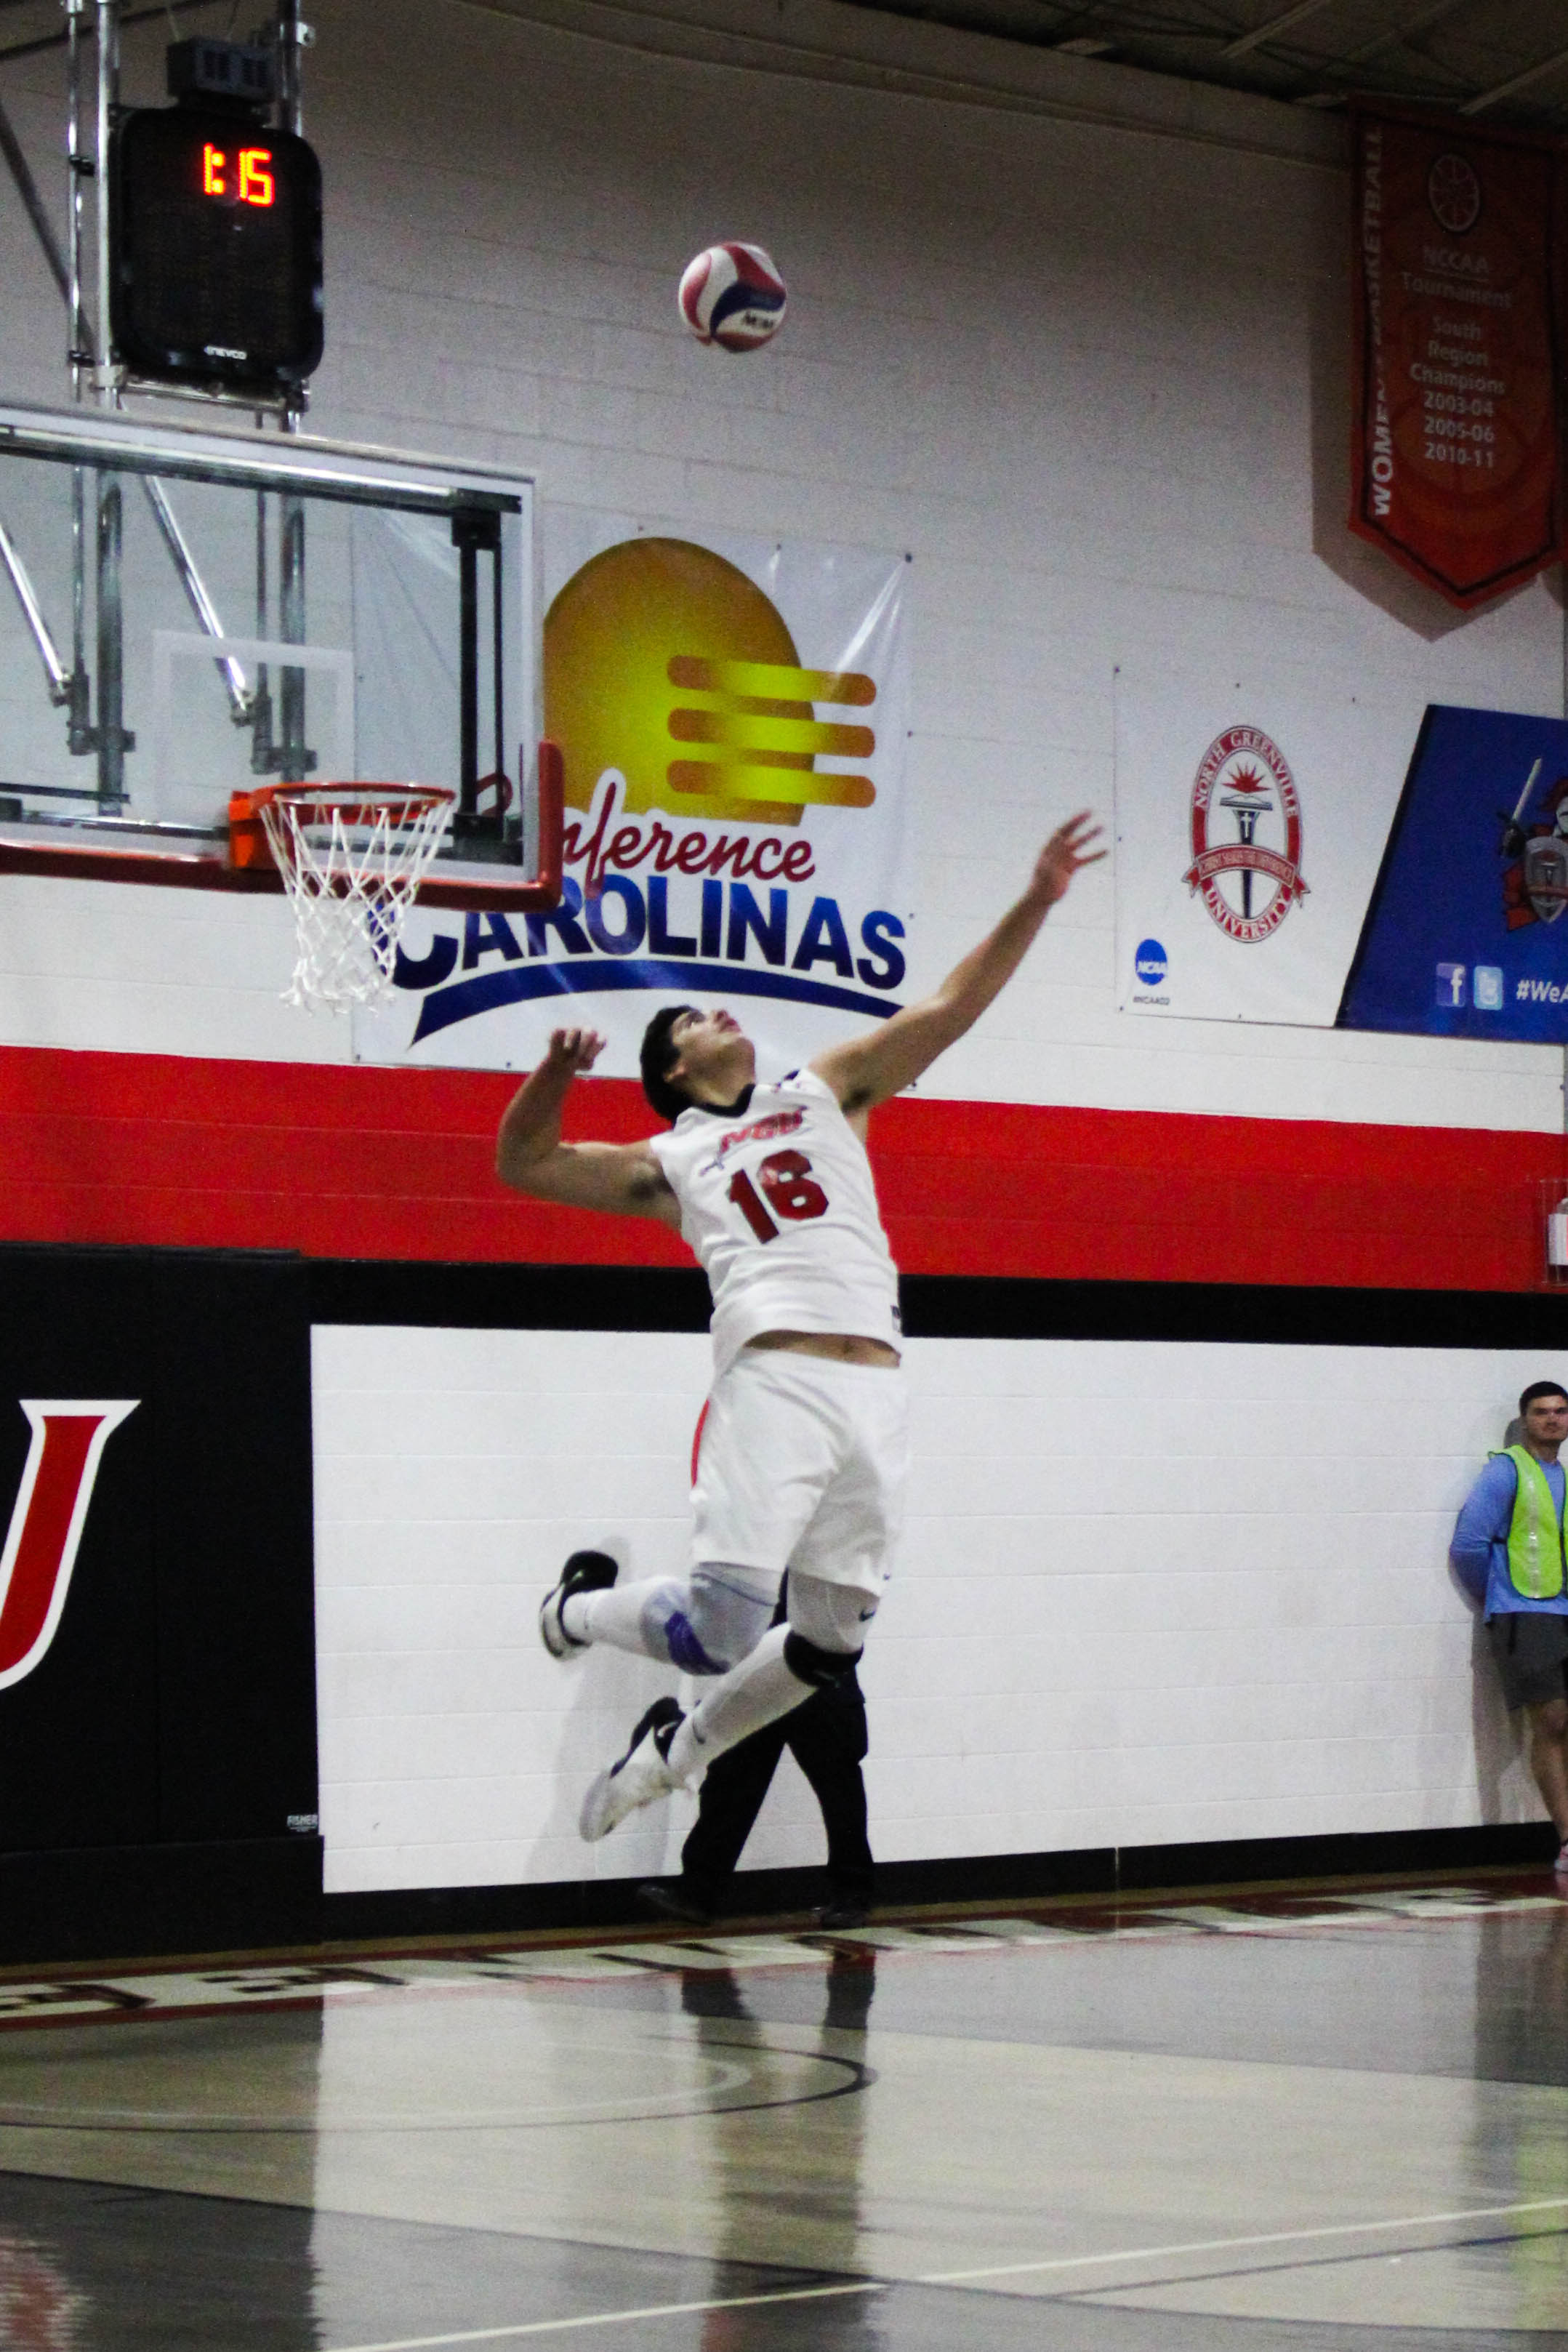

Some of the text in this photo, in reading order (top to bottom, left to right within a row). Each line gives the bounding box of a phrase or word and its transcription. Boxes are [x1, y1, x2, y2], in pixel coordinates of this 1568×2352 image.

[1402, 272, 1513, 308] Tournament
[1433, 316, 1481, 340] South
[1428, 340, 1489, 366] Region
[1410, 363, 1505, 395] Champions
[1424, 390, 1495, 417] 2003-04
[1424, 416, 1495, 443] 2005-06
[1424, 443, 1495, 468] 2010-11
[1194, 729, 1297, 817] NORTH GREENVILLE
[1206, 890, 1292, 939] UNIVERSITY
